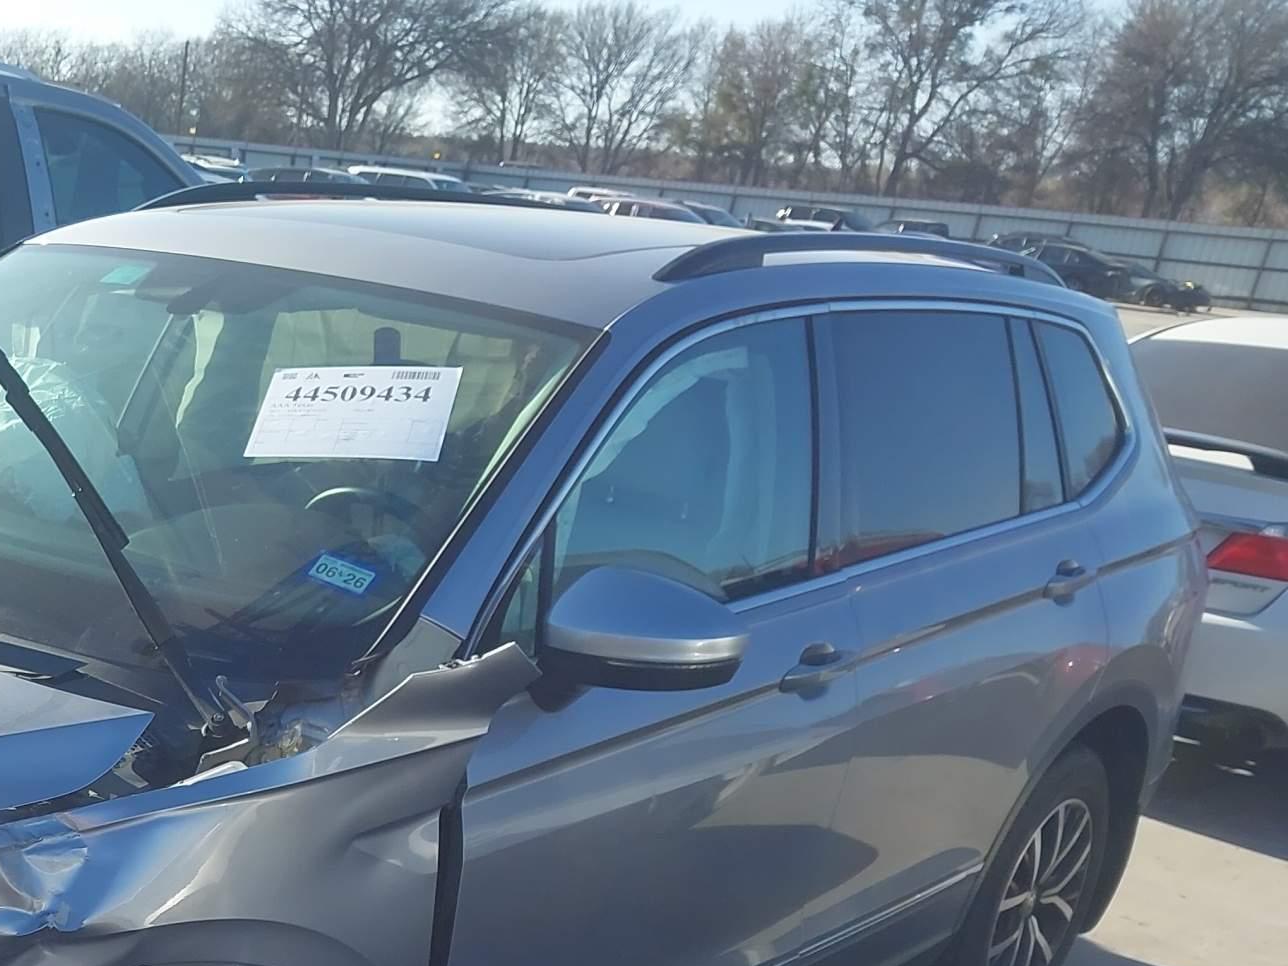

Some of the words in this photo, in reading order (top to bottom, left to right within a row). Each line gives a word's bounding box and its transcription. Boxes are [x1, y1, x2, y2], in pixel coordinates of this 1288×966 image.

[285, 385, 433, 403] 44509434
[315, 563, 338, 578] 06
[343, 573, 367, 589] 26
